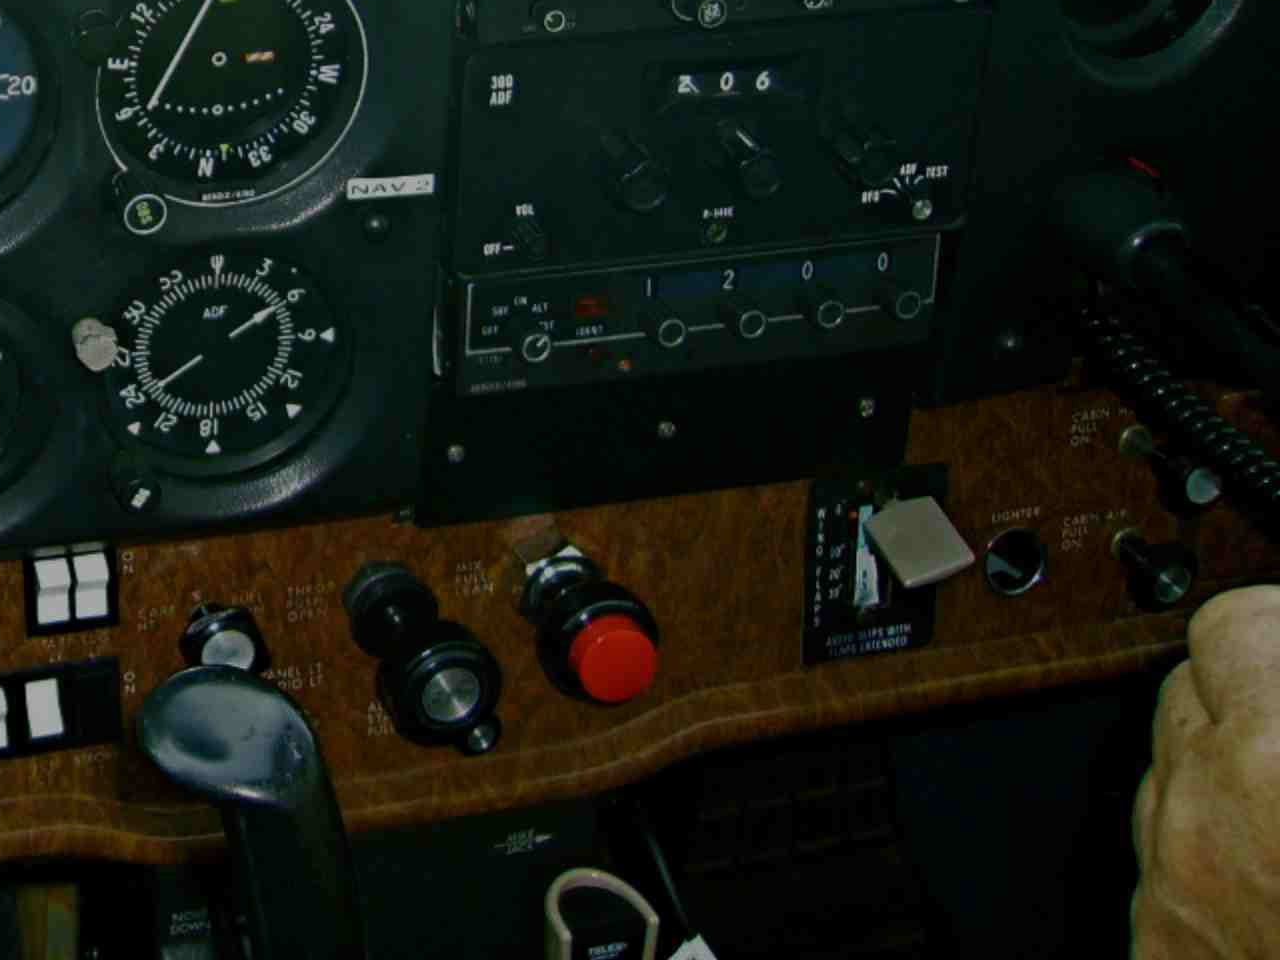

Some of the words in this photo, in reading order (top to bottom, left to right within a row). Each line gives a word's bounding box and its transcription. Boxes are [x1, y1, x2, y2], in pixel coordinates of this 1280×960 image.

[129, 2, 154, 25] 12
[313, 10, 335, 35] 24
[107, 56, 130, 72] E
[318, 63, 342, 84] W
[7, 75, 38, 96] 20
[489, 73, 514, 90] 300
[488, 90, 513, 107] ADF
[291, 110, 318, 136] 30
[197, 156, 215, 178] N
[248, 144, 273, 169] 33
[351, 181, 407, 195] NAV
[255, 257, 275, 278] 3
[722, 268, 736, 292] 2
[800, 260, 814, 281] 0
[877, 252, 889, 273] 0
[159, 269, 185, 291] 33
[287, 288, 307, 303] 6
[122, 299, 146, 326] 30
[202, 304, 229, 321] ADF
[297, 327, 318, 342] 9
[279, 368, 304, 389] 12
[153, 411, 179, 433] 21
[245, 400, 269, 423] 15
[198, 418, 219, 438] 18
[992, 505, 1041, 522] LIGHTER
